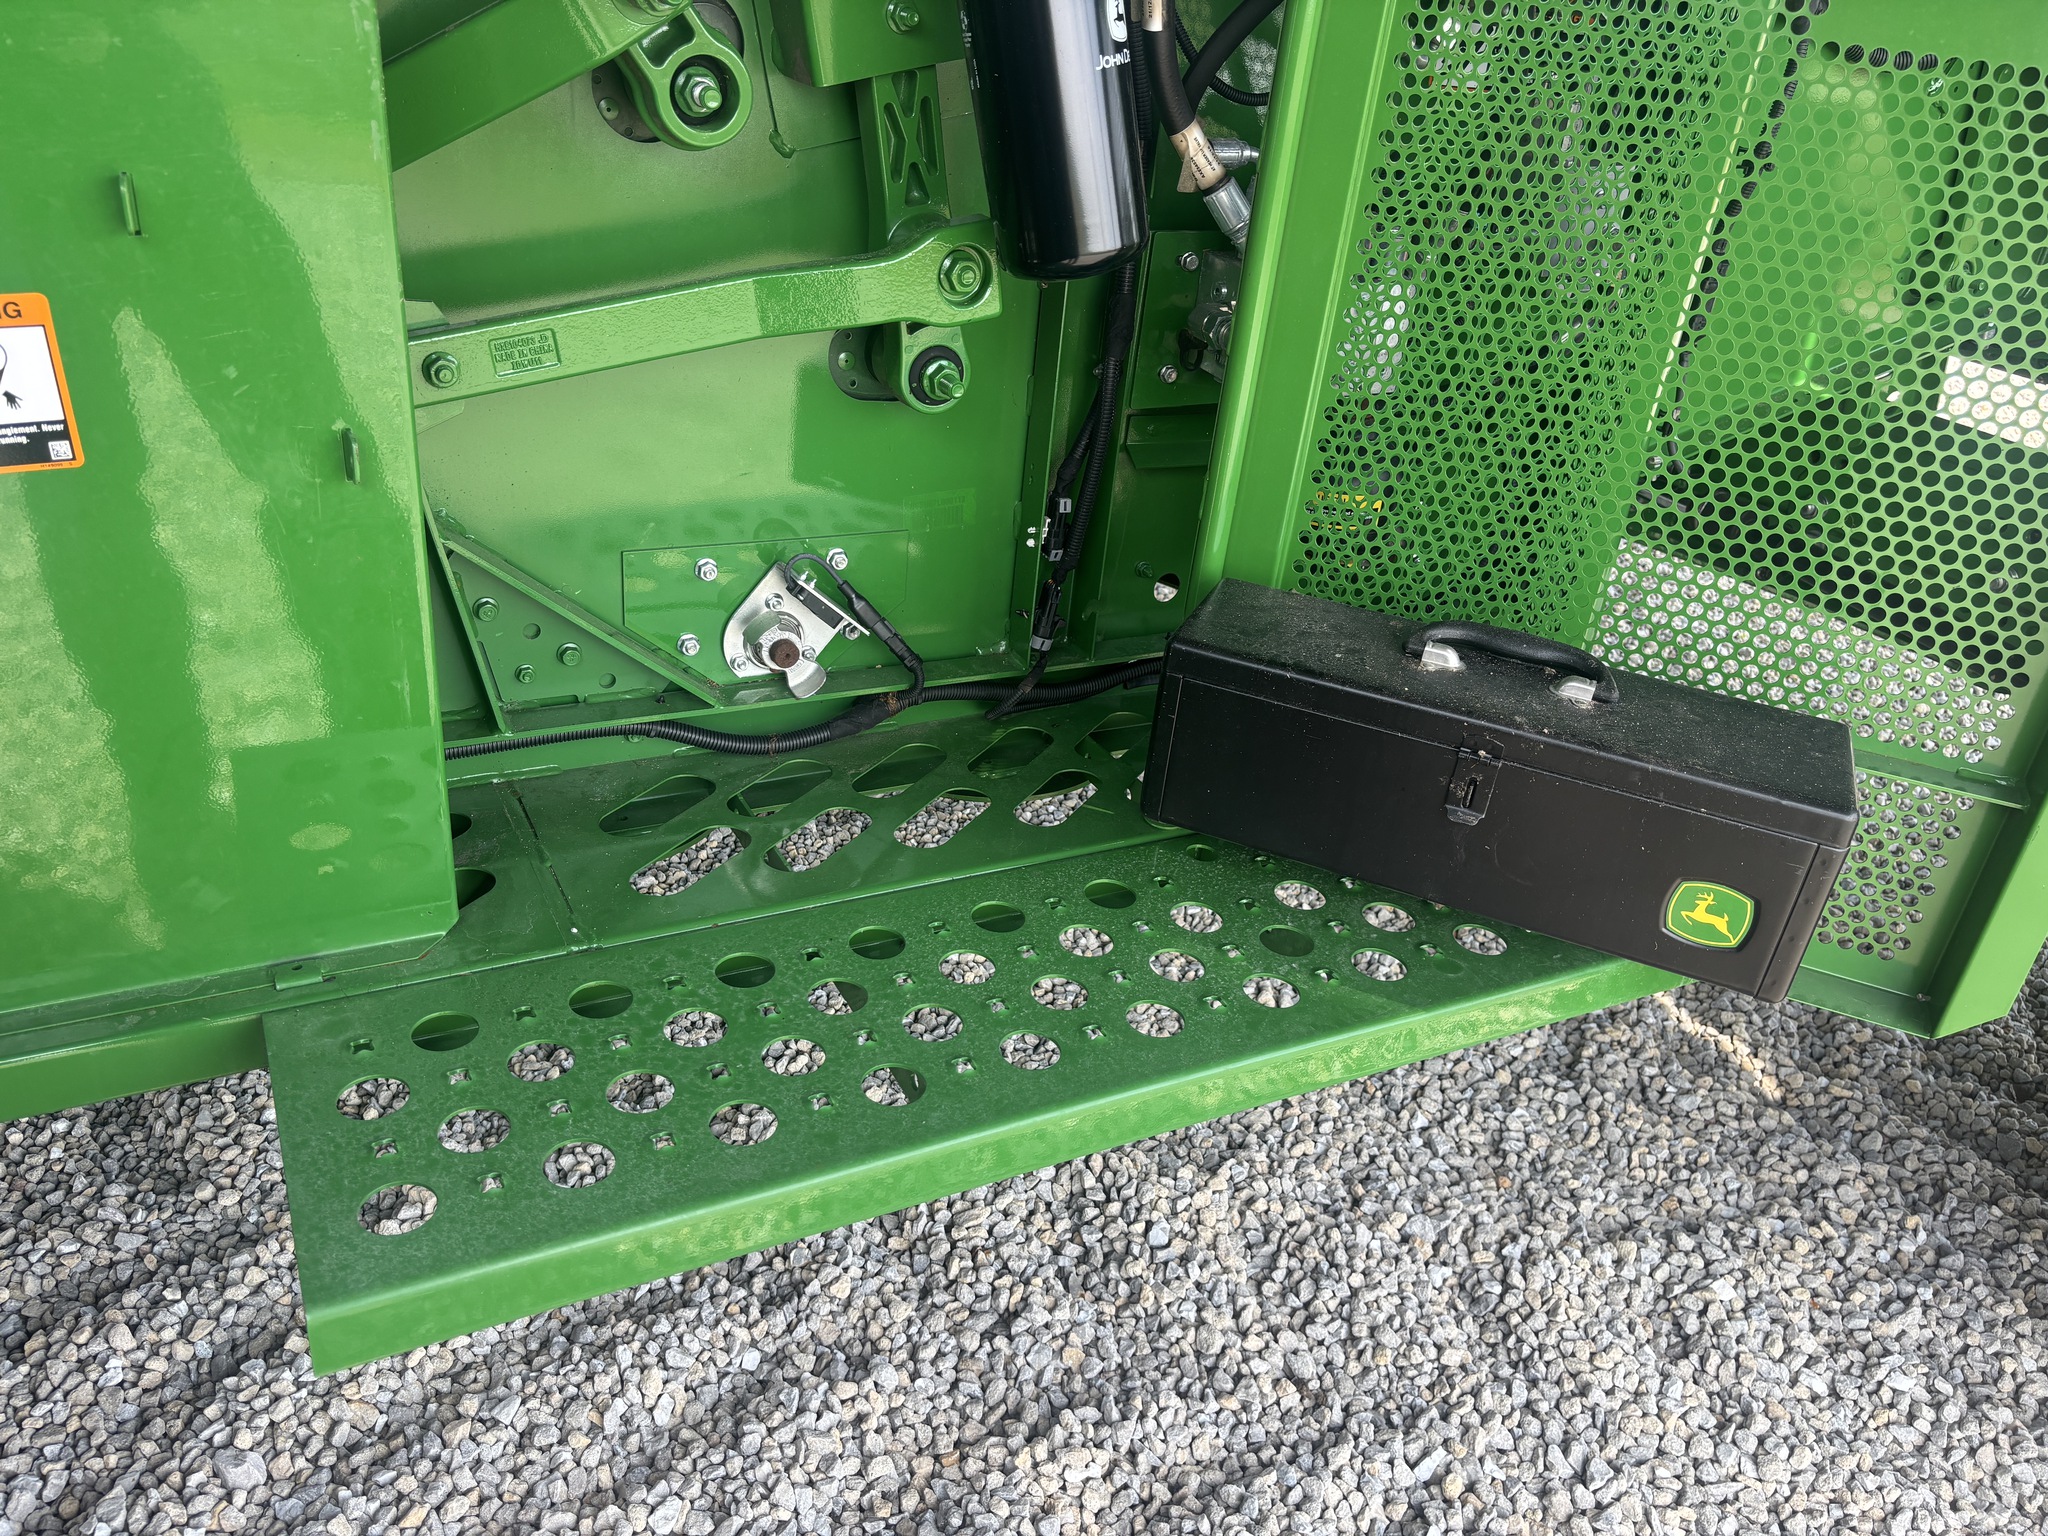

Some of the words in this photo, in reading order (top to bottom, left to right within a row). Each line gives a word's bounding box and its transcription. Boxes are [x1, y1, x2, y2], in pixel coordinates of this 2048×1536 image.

[1096, 51, 1124, 71] JOHN
[0, 301, 23, 319] G
[538, 333, 549, 344] JD
[494, 351, 517, 363] MADE
[516, 348, 529, 359] IN
[528, 342, 555, 357] CHINA
[41, 423, 64, 432] Never
